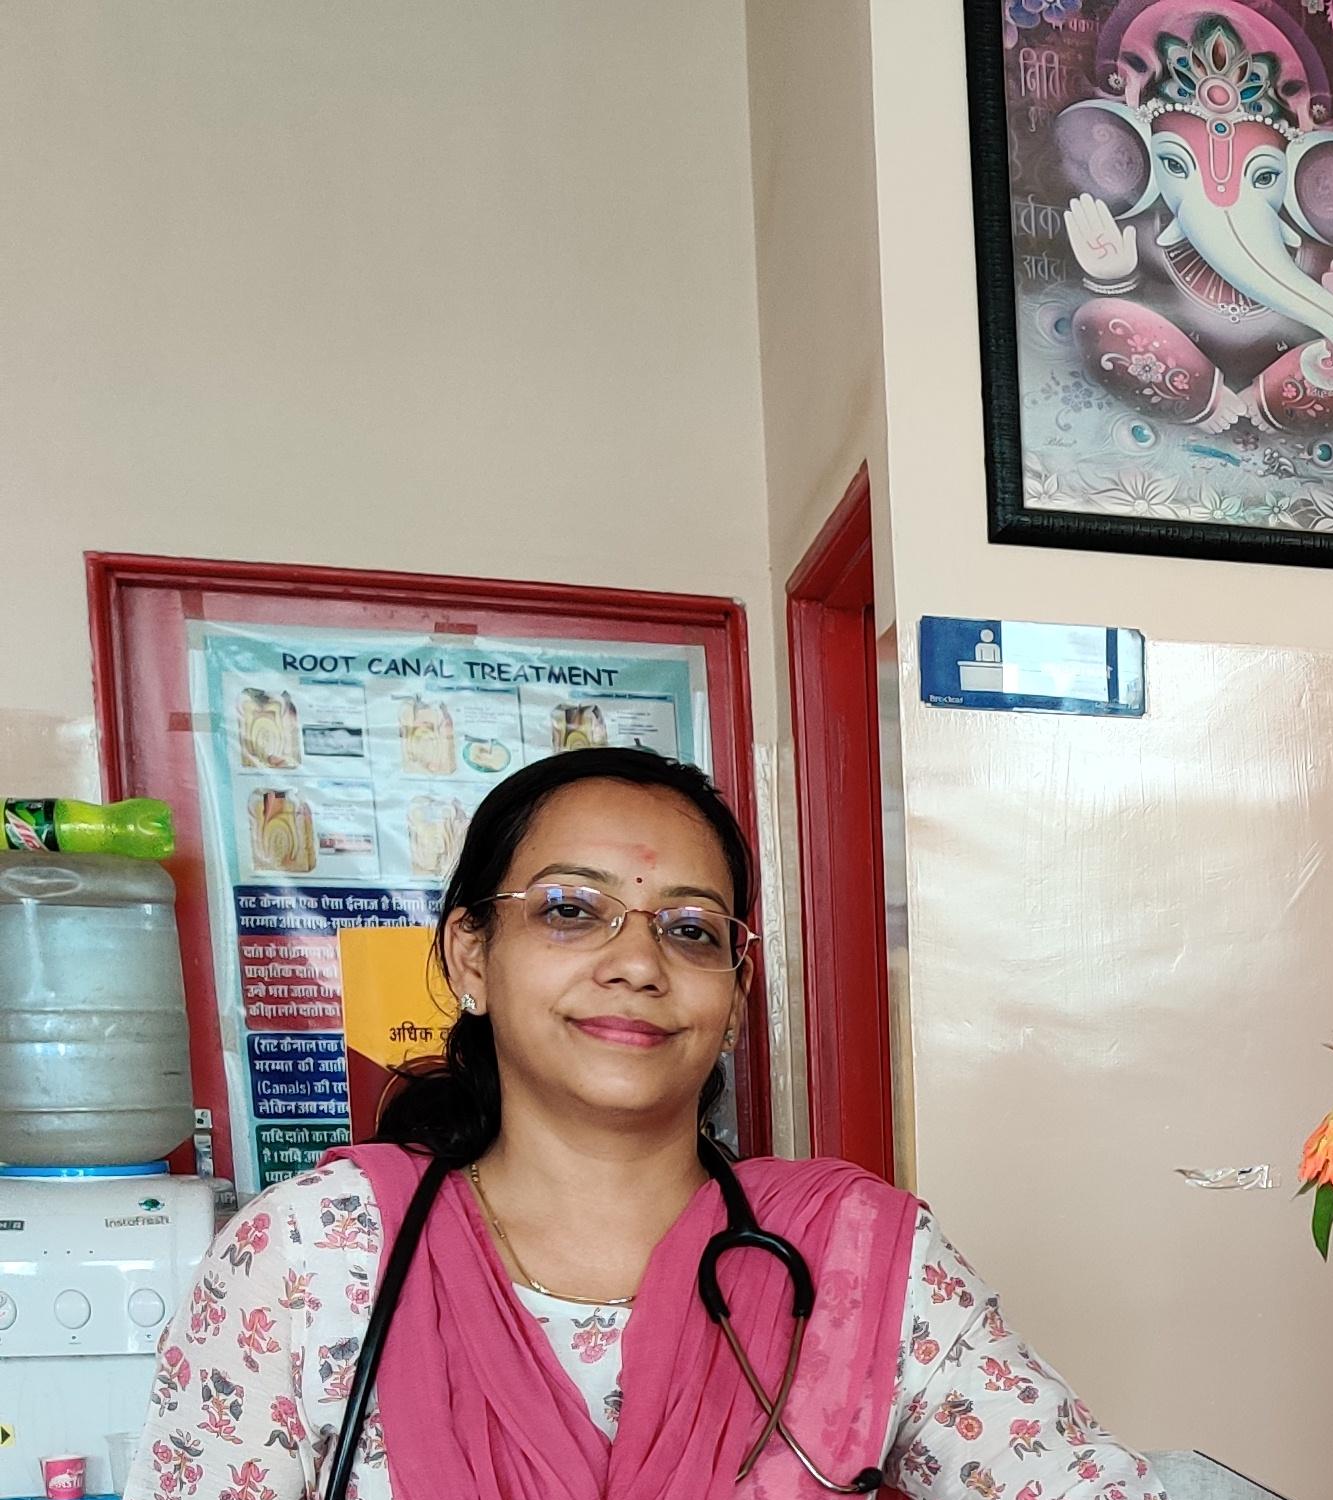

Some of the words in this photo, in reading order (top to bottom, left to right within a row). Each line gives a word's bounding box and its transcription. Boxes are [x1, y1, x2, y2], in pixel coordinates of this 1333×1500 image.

[282, 653, 357, 674] ROOT
[367, 656, 454, 679] CANAL
[463, 660, 619, 687] TREATMENT
[390, 1020, 433, 1043] अधिक
[317, 1039, 340, 1052] एक
[296, 1056, 315, 1073] की
[257, 1080, 311, 1097] (Canals)
[312, 1078, 330, 1094] की
[261, 1128, 284, 1144] यदि
[310, 1131, 328, 1143] का
